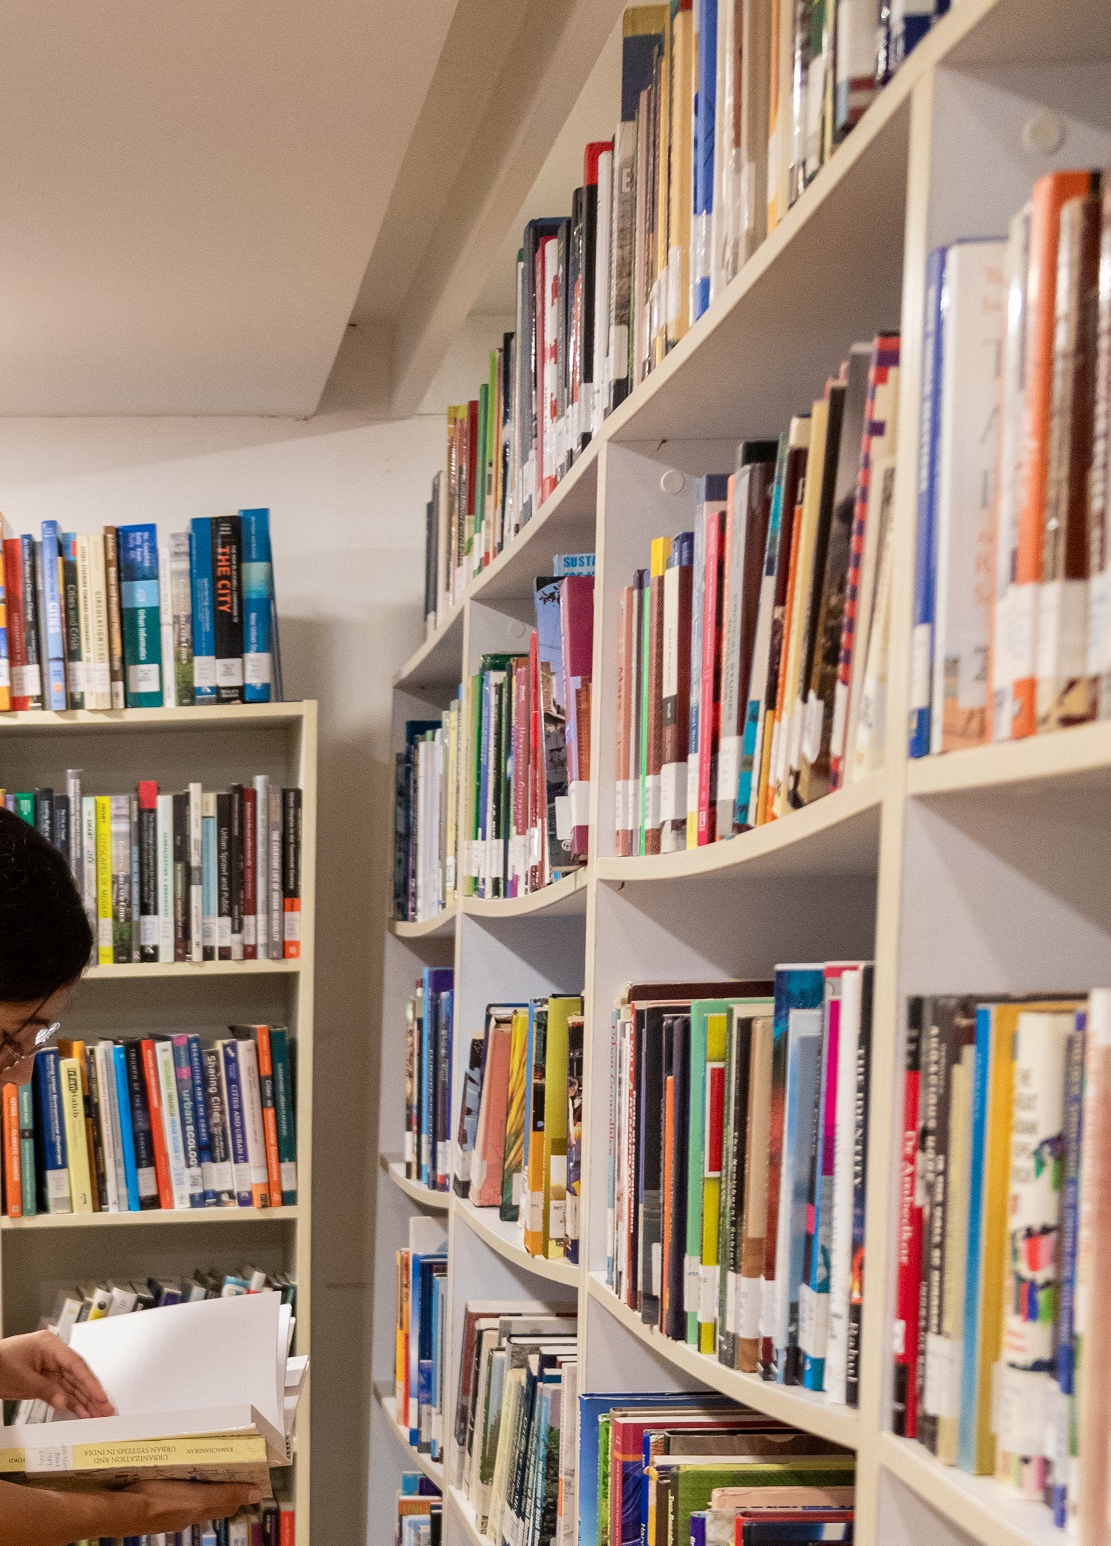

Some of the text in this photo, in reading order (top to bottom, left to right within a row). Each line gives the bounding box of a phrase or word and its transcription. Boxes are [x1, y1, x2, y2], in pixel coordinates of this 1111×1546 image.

[217, 546, 231, 613] THE CITY
[68, 585, 76, 608] Cities
[69, 610, 77, 625] and
[220, 852, 228, 875] Sprawl
[207, 1055, 220, 1123] Sharing Cities
[182, 1090, 195, 1124] urban
[115, 1454, 168, 1462] URBANIZATION
